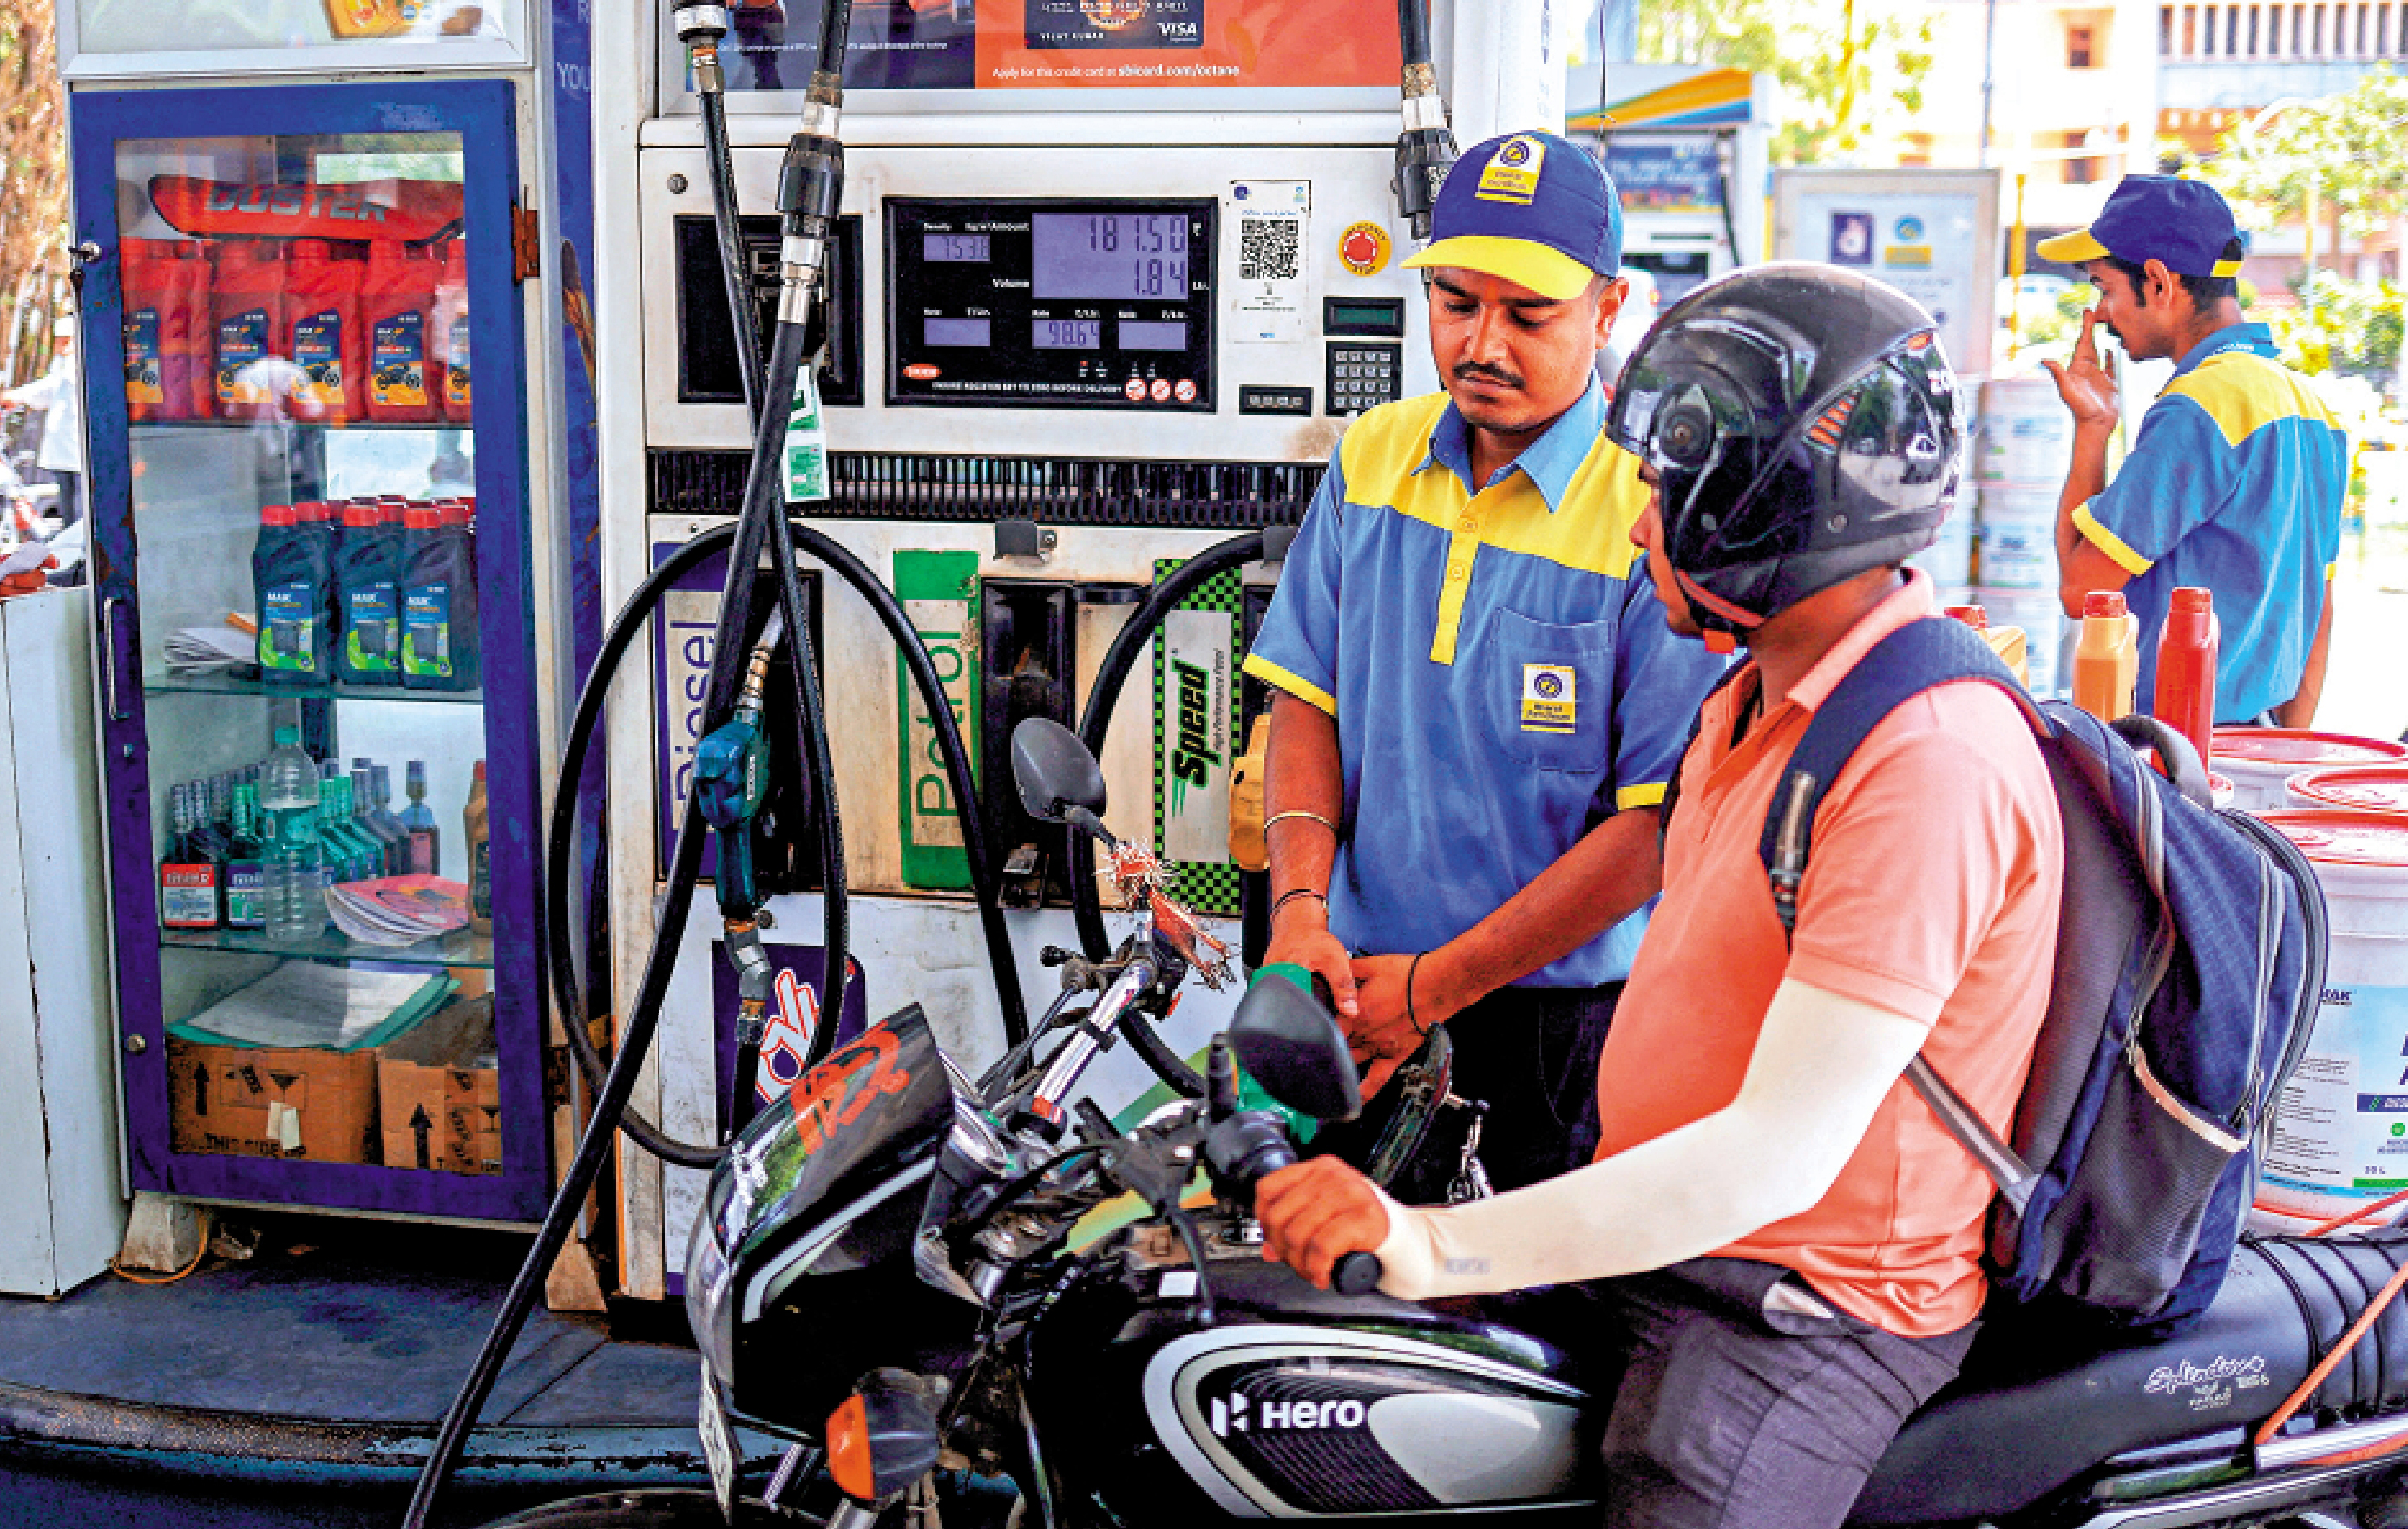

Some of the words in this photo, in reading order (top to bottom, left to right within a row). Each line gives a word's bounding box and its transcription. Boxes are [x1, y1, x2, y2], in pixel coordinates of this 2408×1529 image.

[1157, 23, 1197, 36] VISA
[992, 68, 1017, 82] Apply
[1020, 67, 1033, 79] for
[1035, 67, 1052, 78] this
[1054, 66, 1080, 78] credit
[1118, 63, 1239, 79] sbicard.com/octane
[990, 222, 1029, 233] Amount
[1089, 217, 1185, 253] 181.50
[992, 279, 1029, 288] Volume
[1134, 258, 1185, 296] 1.84
[1171, 658, 1222, 789] Speed
[1261, 1399, 1365, 1431] Hero
